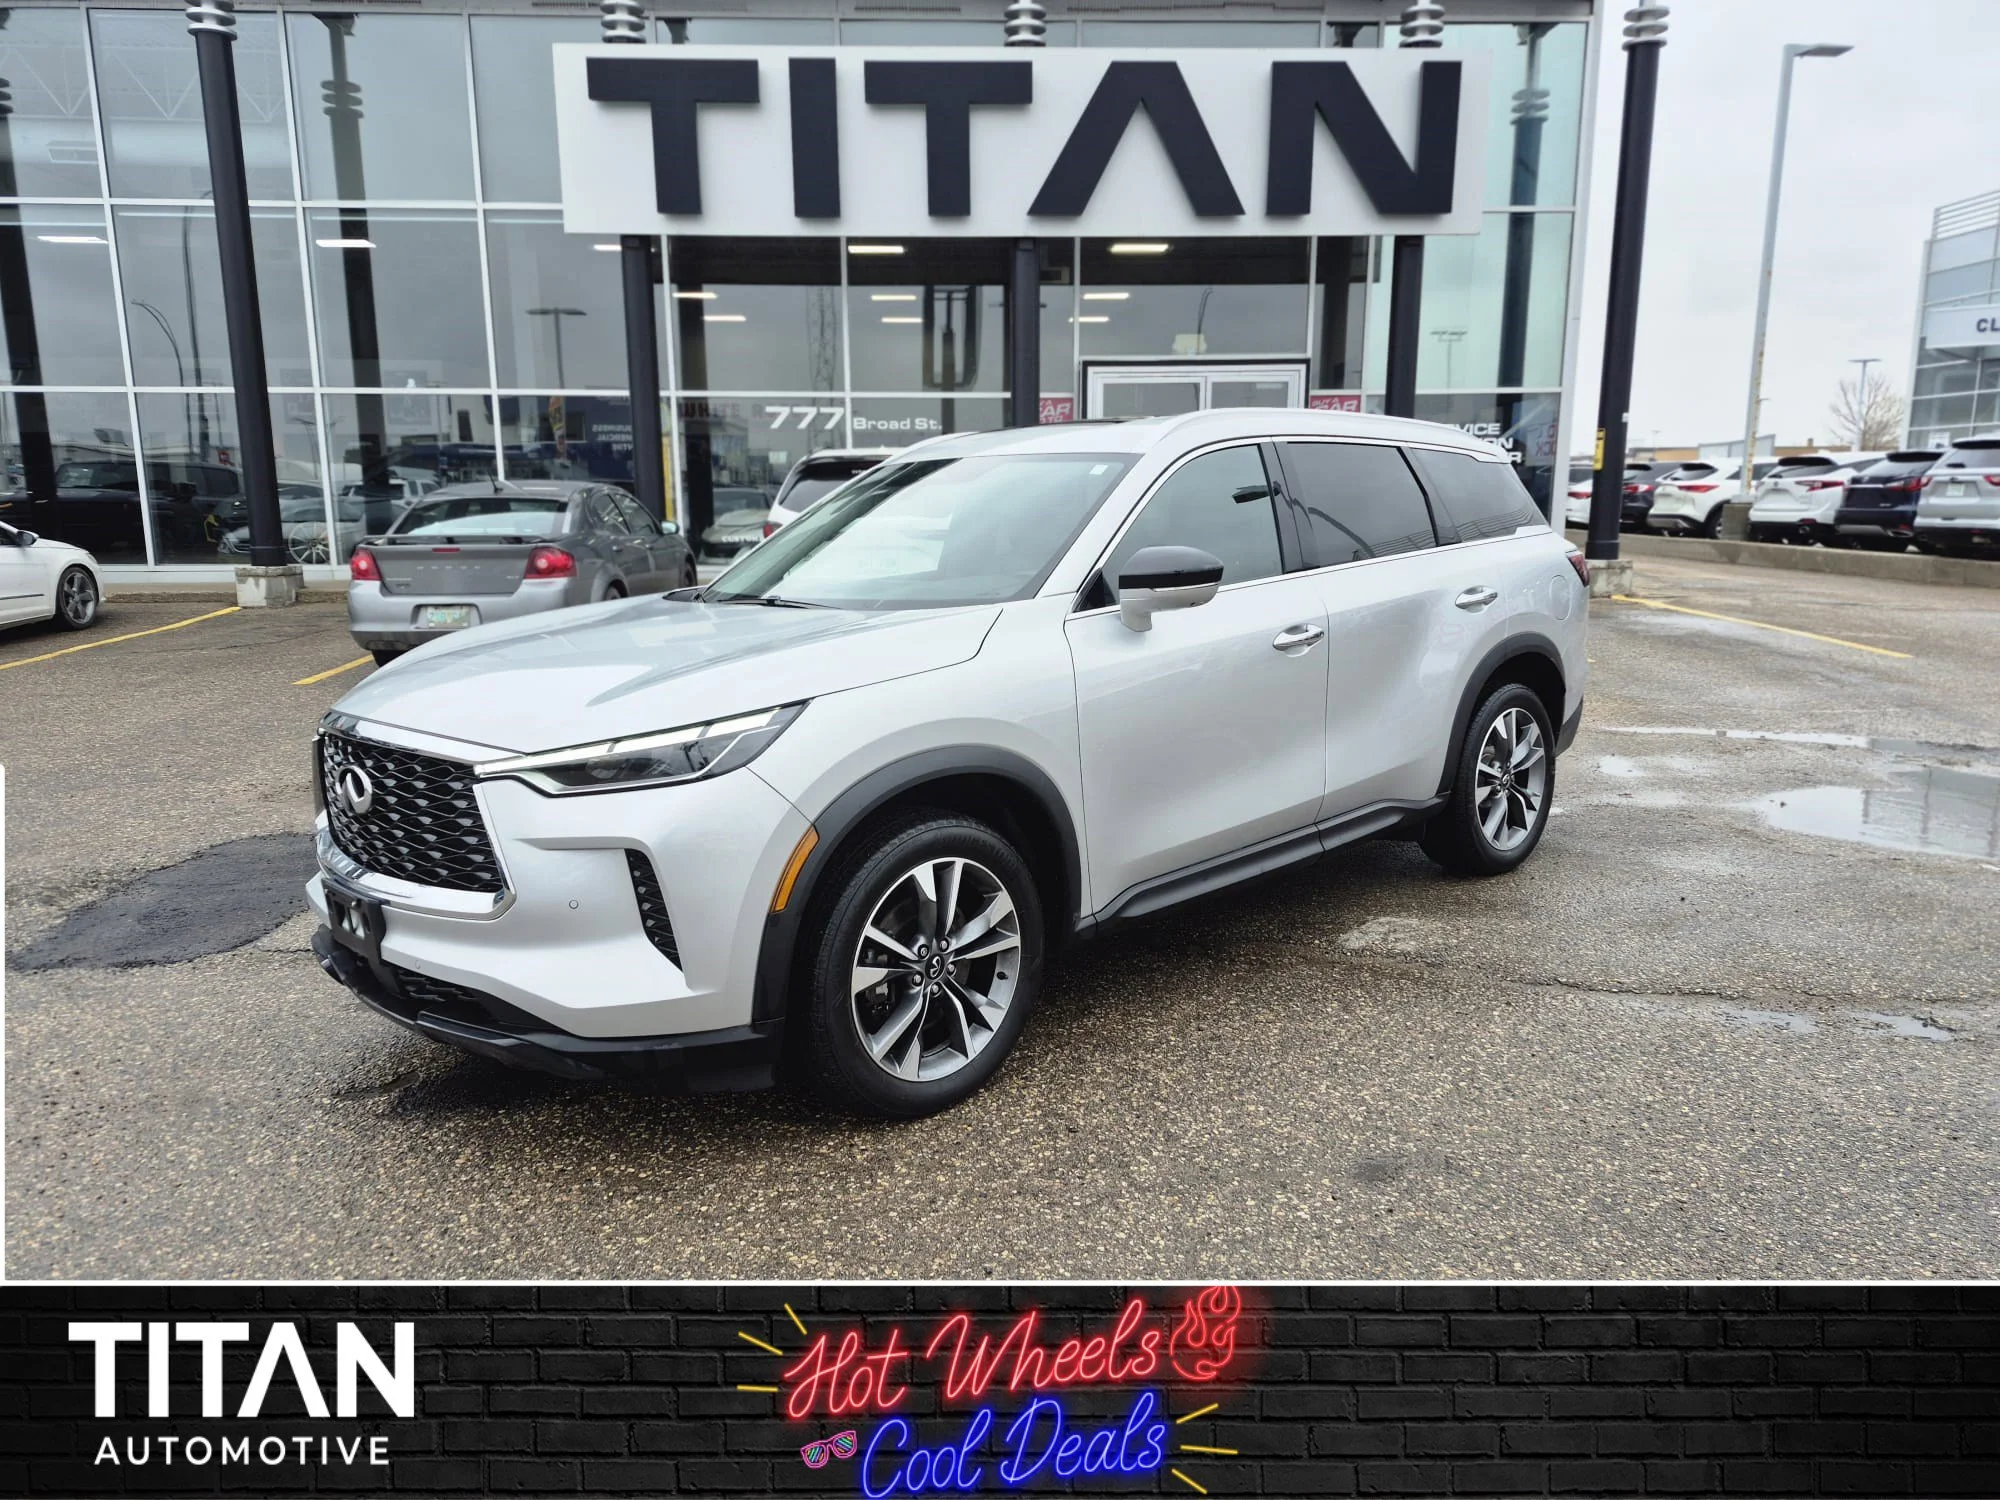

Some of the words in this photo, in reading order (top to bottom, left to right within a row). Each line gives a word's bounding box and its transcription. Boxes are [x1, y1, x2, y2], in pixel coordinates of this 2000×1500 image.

[586, 57, 1462, 219] TITAN
[765, 405, 845, 430] 777
[853, 417, 909, 430] Broad
[914, 417, 943, 431] St.
[1040, 403, 1071, 417] AR
